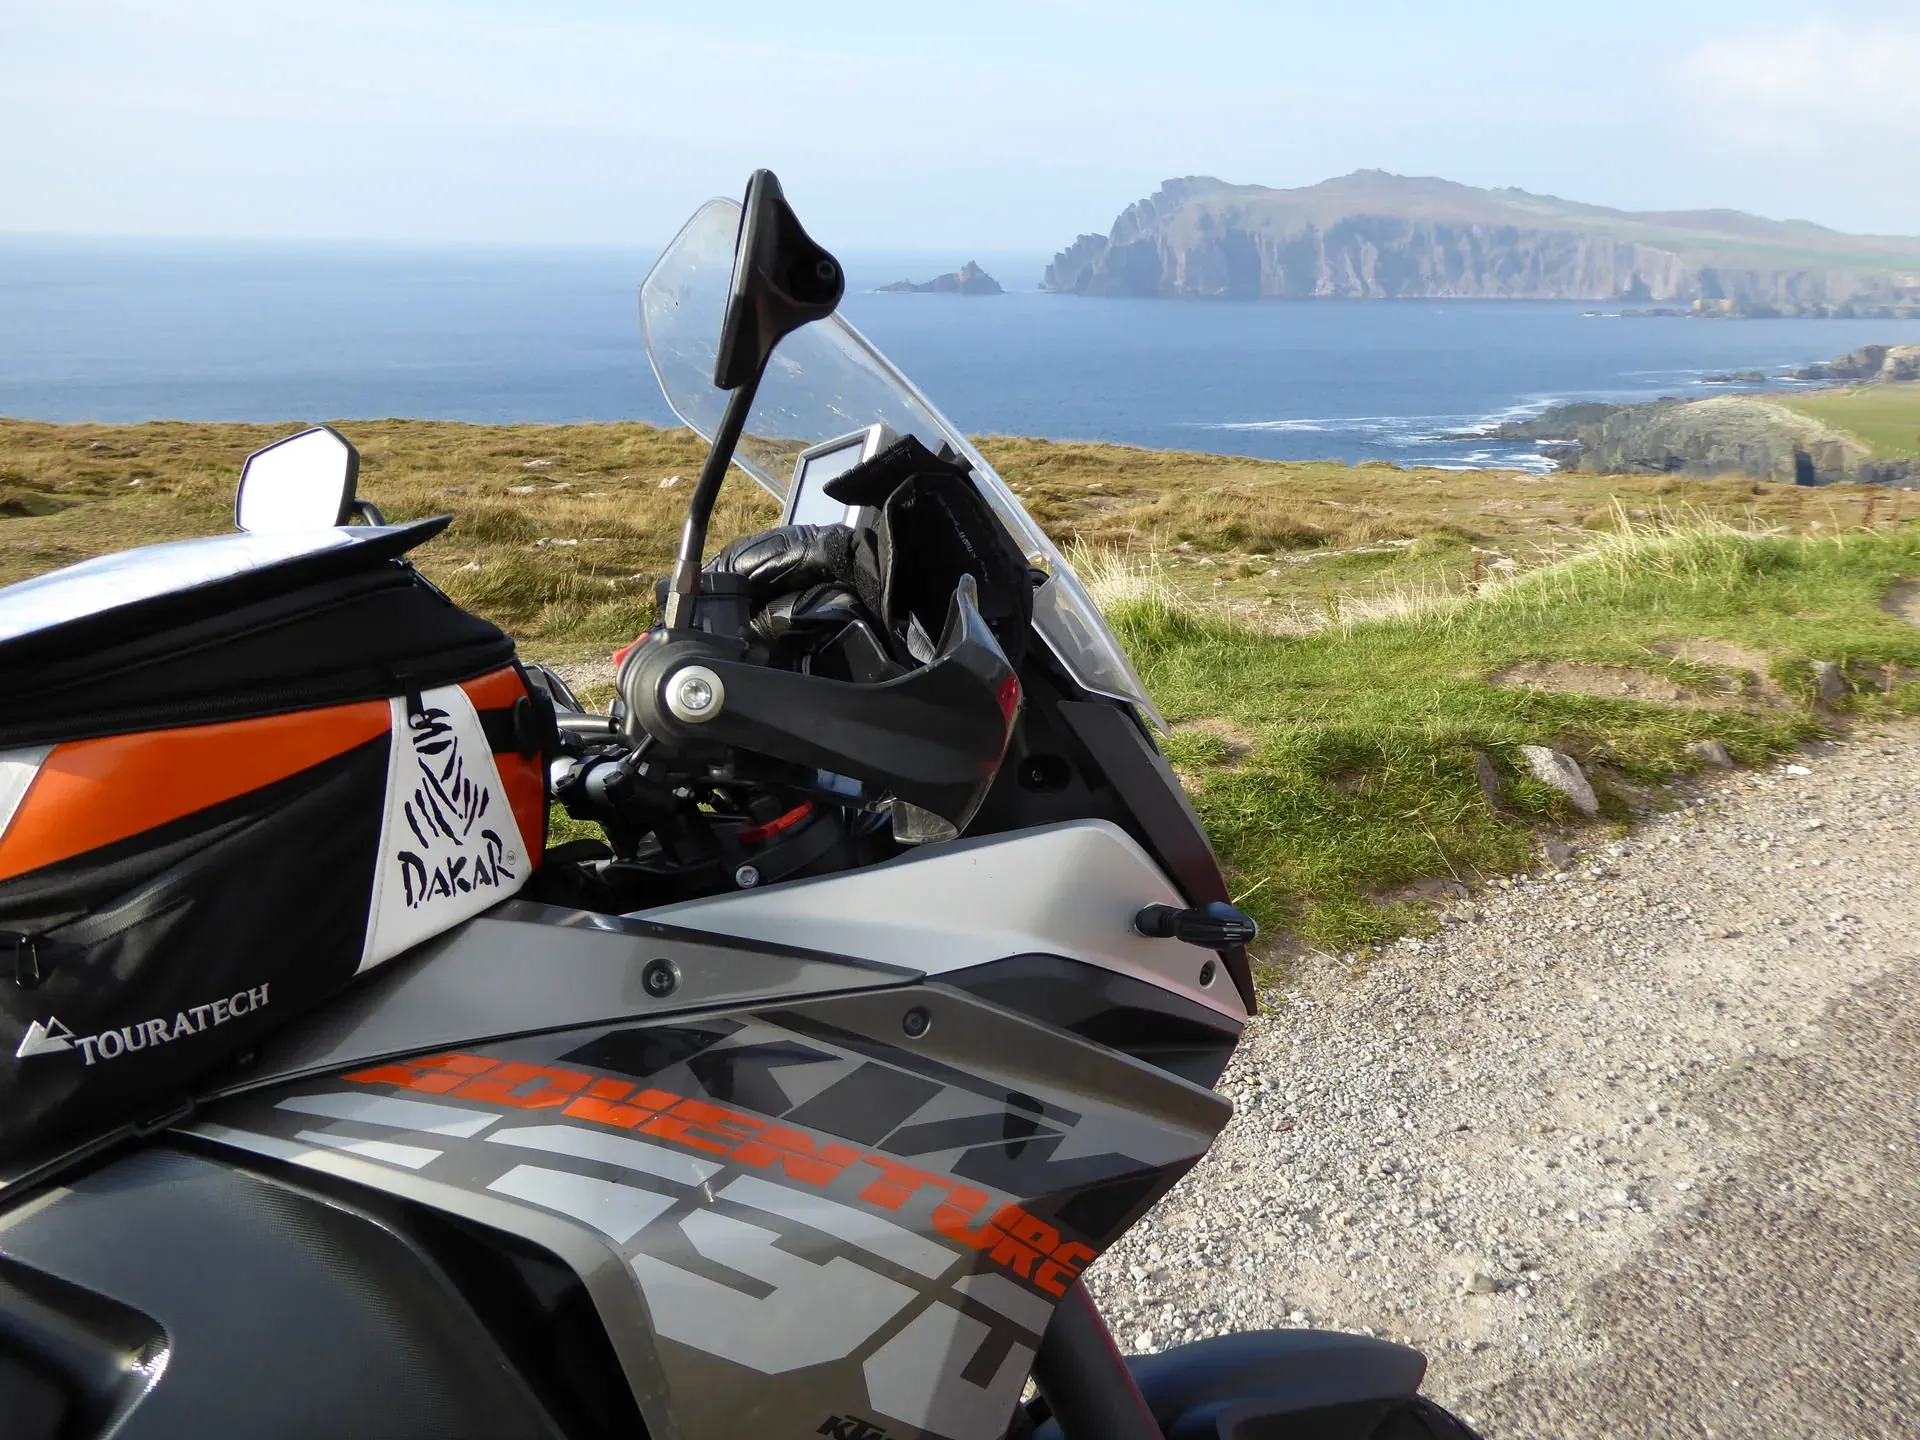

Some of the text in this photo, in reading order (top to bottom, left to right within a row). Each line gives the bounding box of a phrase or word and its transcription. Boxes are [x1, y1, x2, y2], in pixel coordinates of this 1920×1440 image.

[397, 829, 515, 909] DAKAR
[74, 983, 271, 1066] TOURATECH
[340, 1052, 1097, 1298] ADVENTURE
